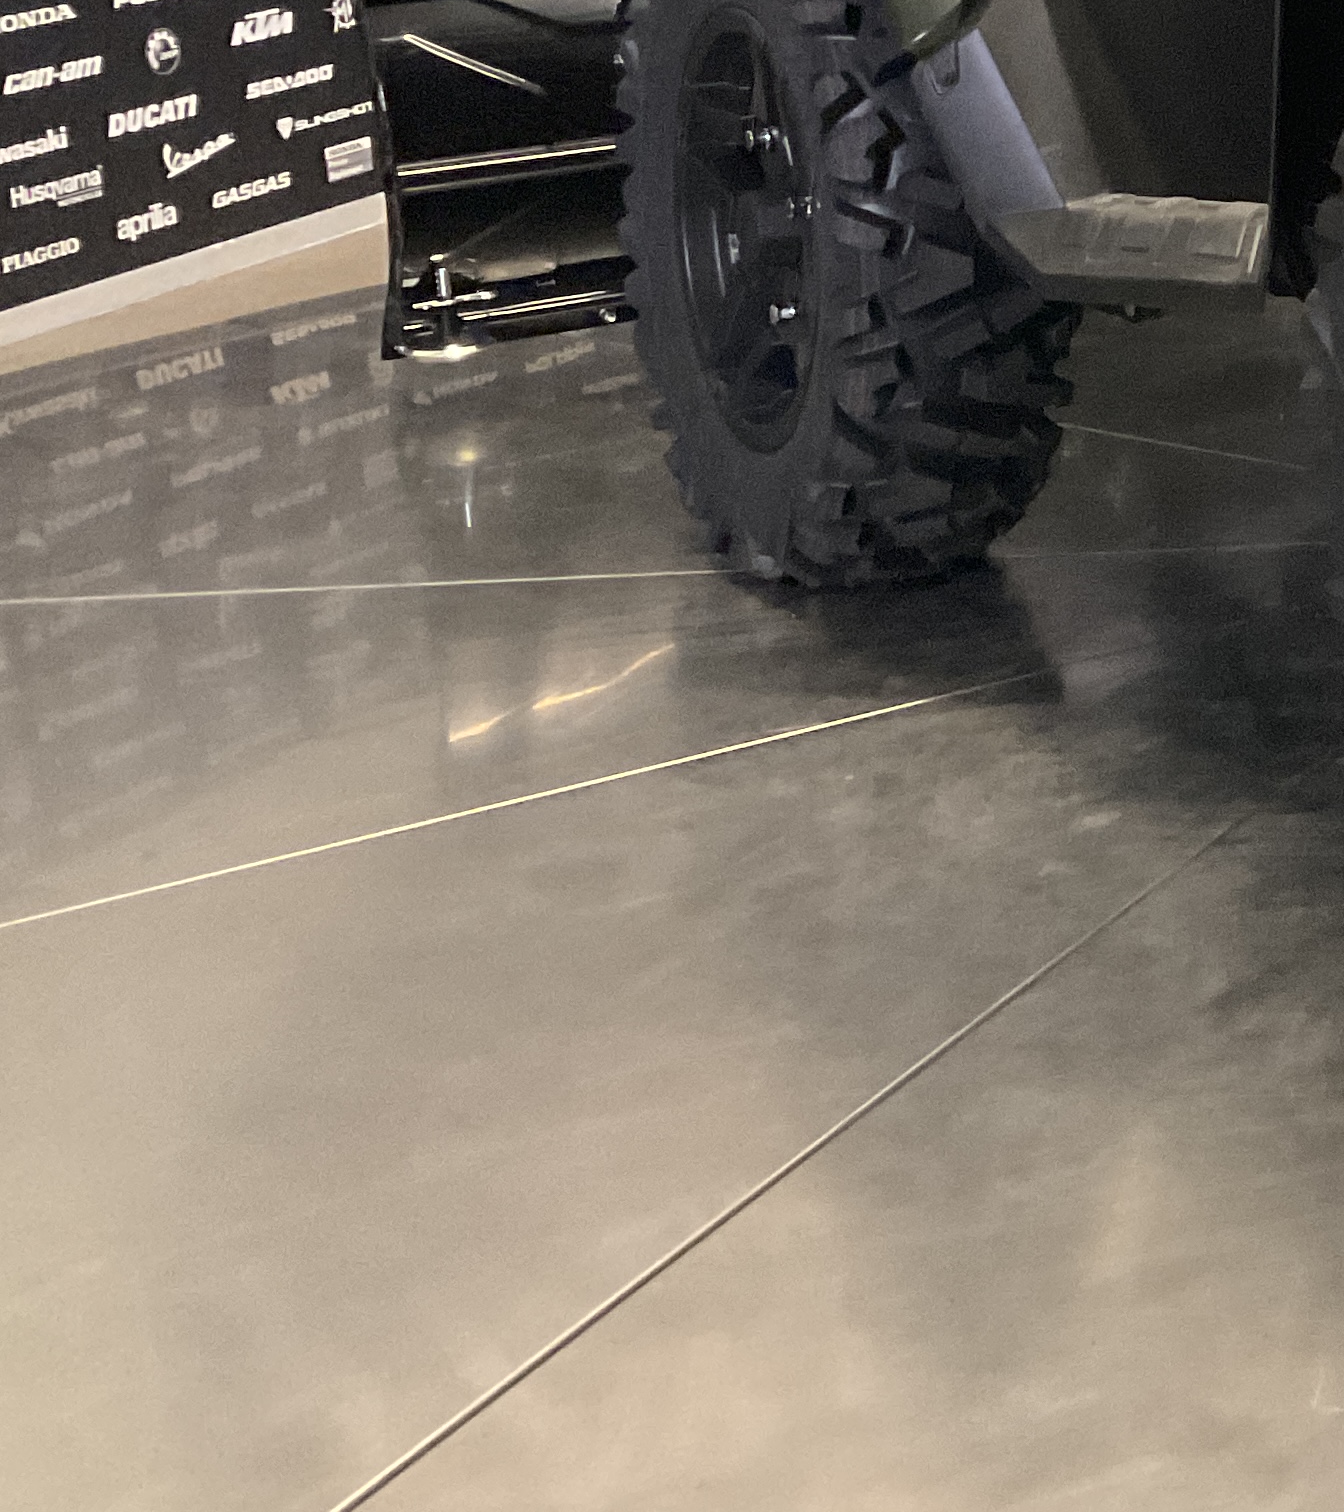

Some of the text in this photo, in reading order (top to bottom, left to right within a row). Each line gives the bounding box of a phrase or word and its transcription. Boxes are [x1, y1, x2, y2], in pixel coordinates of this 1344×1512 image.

[0, 4, 77, 33] ONDA
[231, 8, 293, 46] KTM
[4, 56, 102, 95] can-am
[109, 94, 197, 137] DUCATI
[10, 168, 102, 208] Husqvarna
[213, 172, 291, 208] GASGAS
[118, 203, 177, 241] aprilia
[2, 238, 80, 273] PIAGGIO
